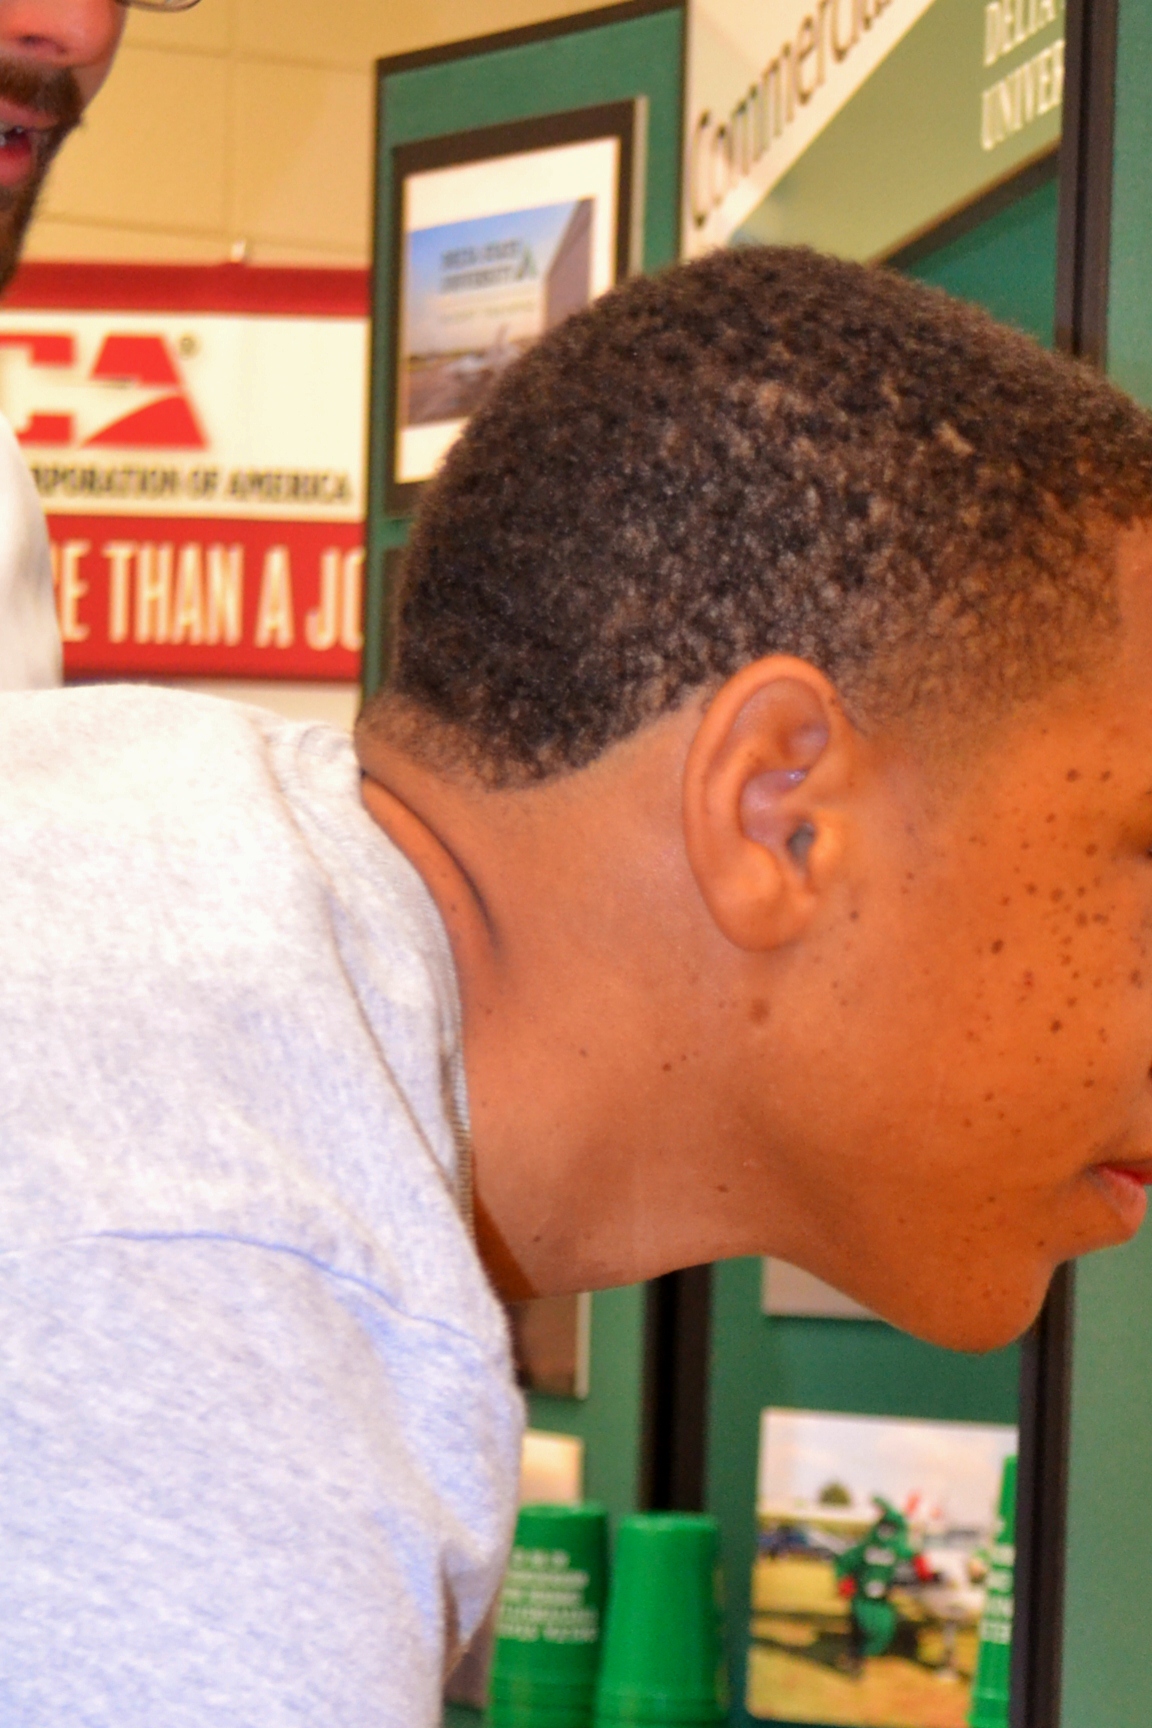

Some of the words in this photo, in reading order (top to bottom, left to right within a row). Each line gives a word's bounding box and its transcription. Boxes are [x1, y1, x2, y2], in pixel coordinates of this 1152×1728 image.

[191, 469, 219, 500] OF
[229, 470, 350, 504] AMERICA
[102, 539, 245, 647] THAN
[254, 545, 296, 649] A
